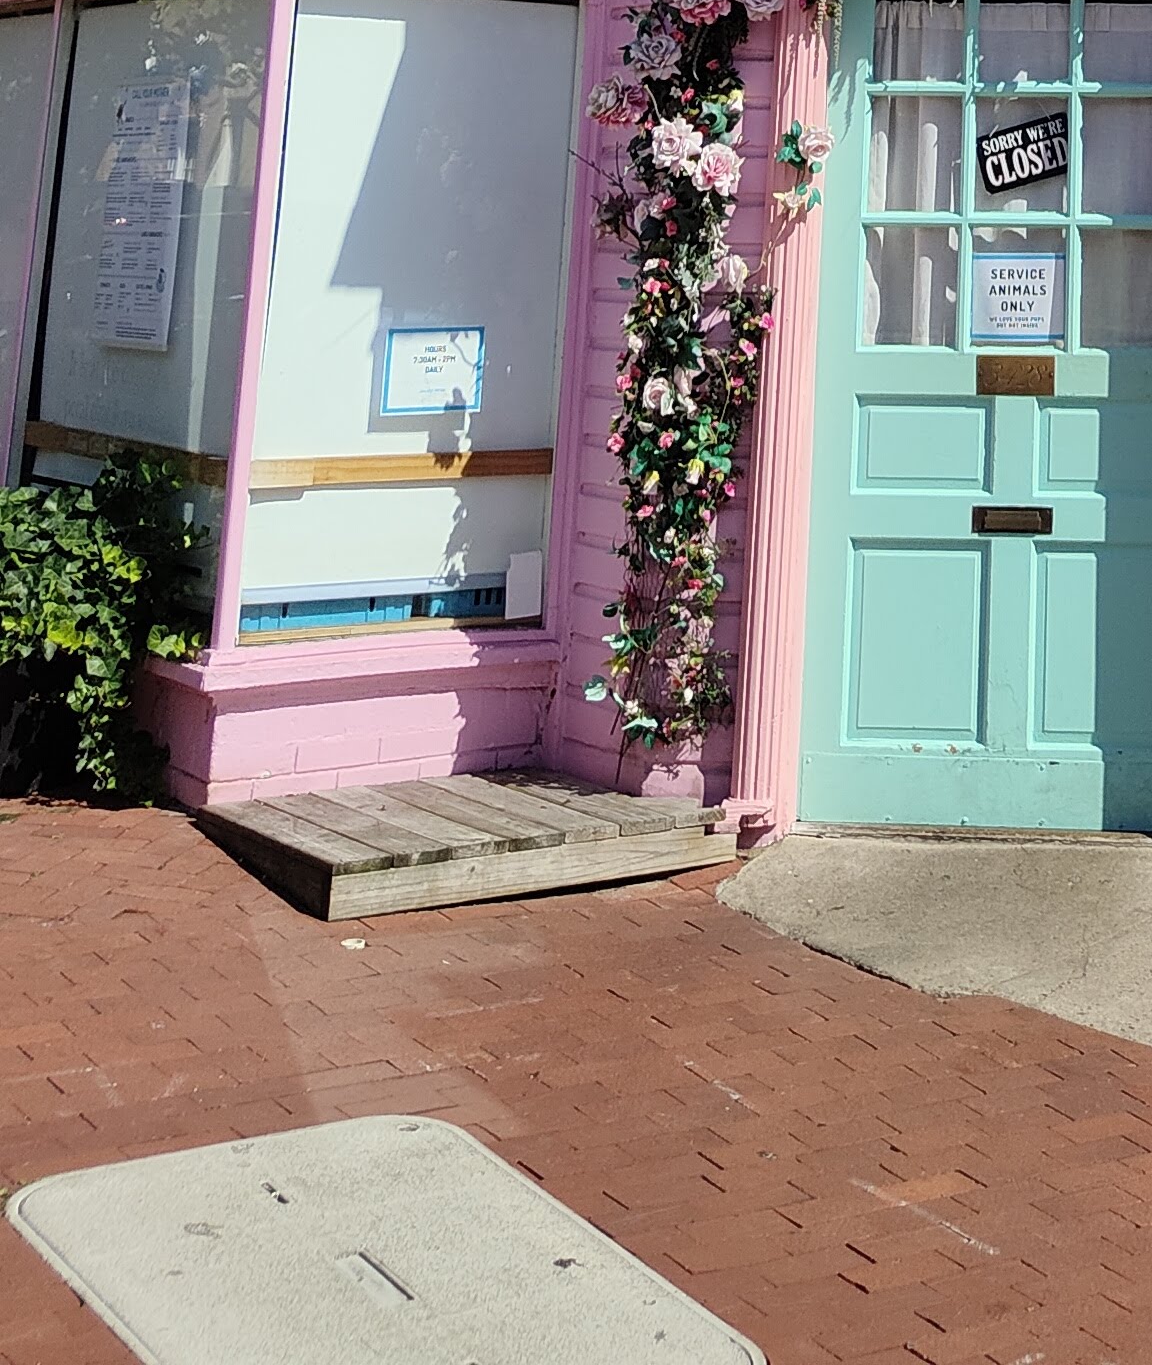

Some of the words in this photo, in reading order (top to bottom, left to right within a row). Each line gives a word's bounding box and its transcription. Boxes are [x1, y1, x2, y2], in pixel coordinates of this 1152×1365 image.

[982, 129, 1023, 156] SORRY
[1026, 118, 1065, 142] WE'RE
[985, 136, 1068, 187] CLOSED
[991, 268, 1046, 280] SERVICE
[989, 284, 1047, 296] ANIMALS
[1000, 301, 1035, 312] ONLY
[424, 345, 447, 353] HOURS
[442, 355, 456, 363] 2PM
[425, 366, 443, 374] DAILY
